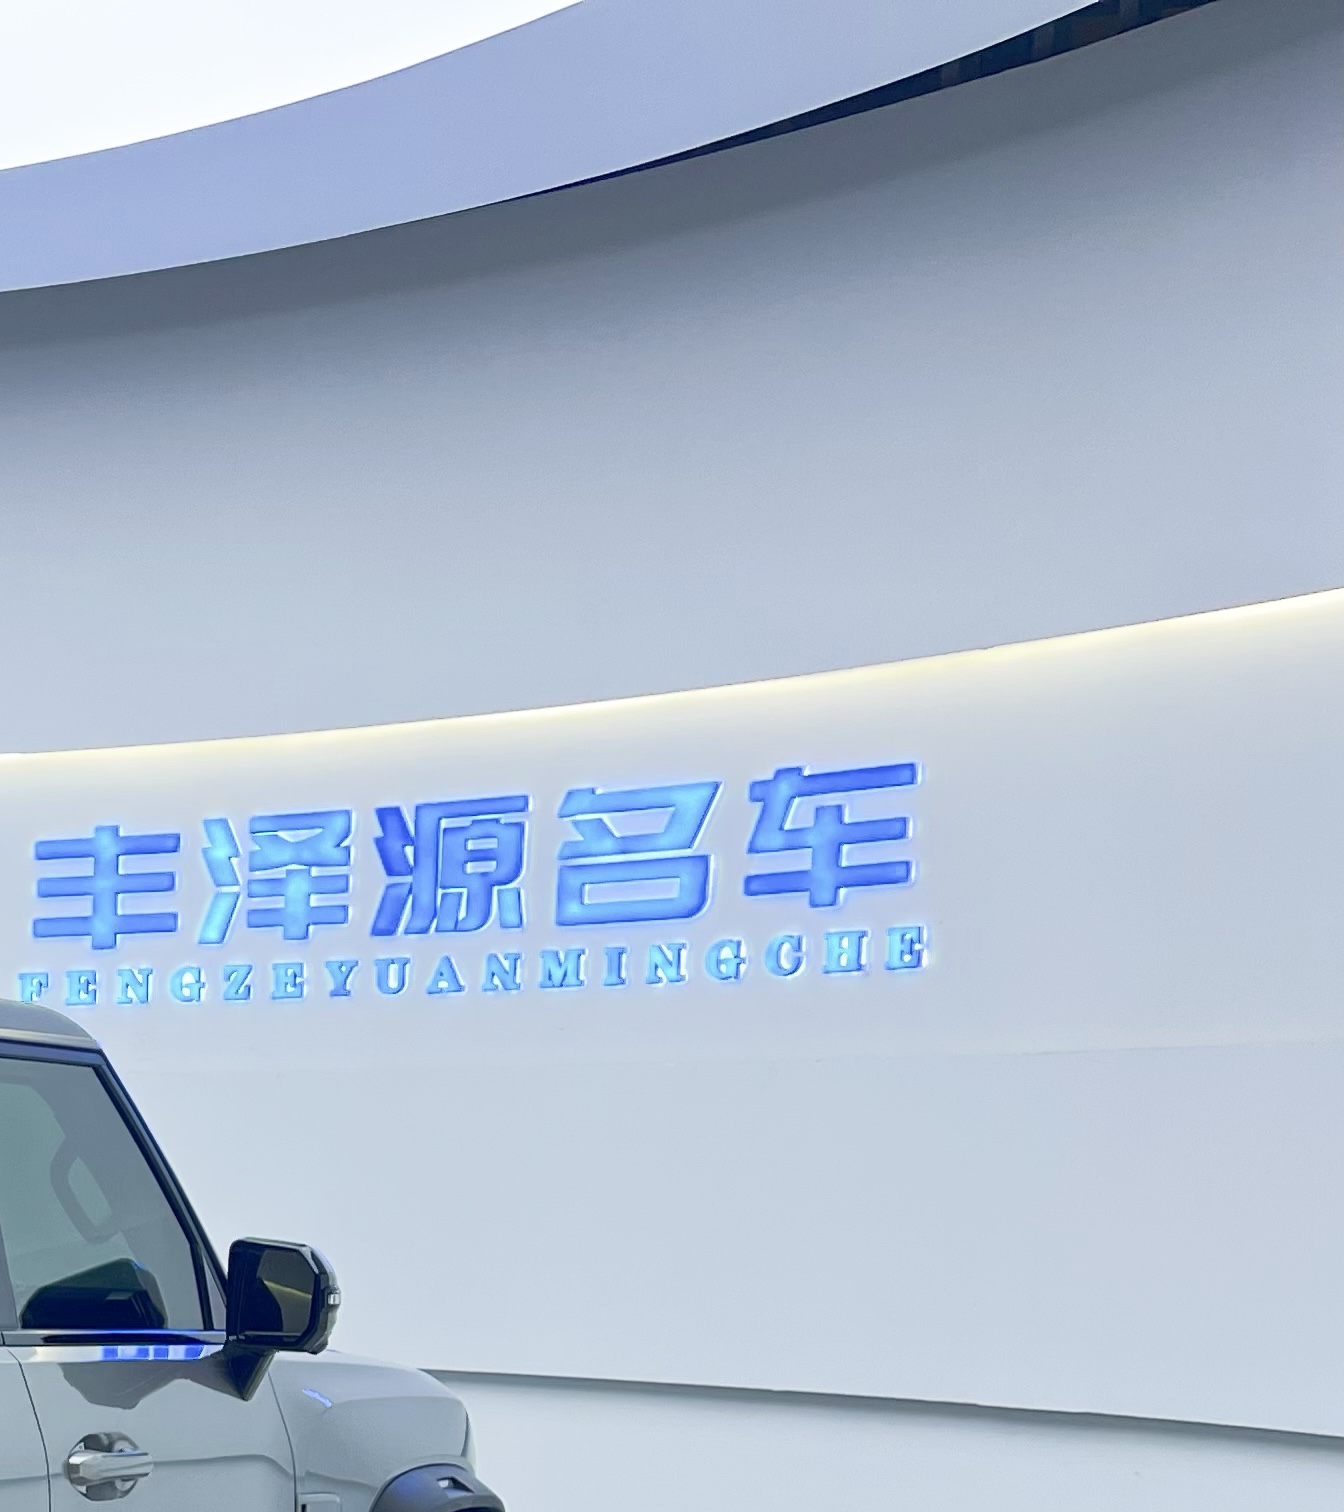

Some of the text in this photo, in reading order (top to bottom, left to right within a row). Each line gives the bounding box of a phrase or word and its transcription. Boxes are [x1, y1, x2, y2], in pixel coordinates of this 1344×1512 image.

[31, 762, 918, 949] 丰泽源名车
[17, 925, 926, 1006] FENGZEYUANMINGCHE
